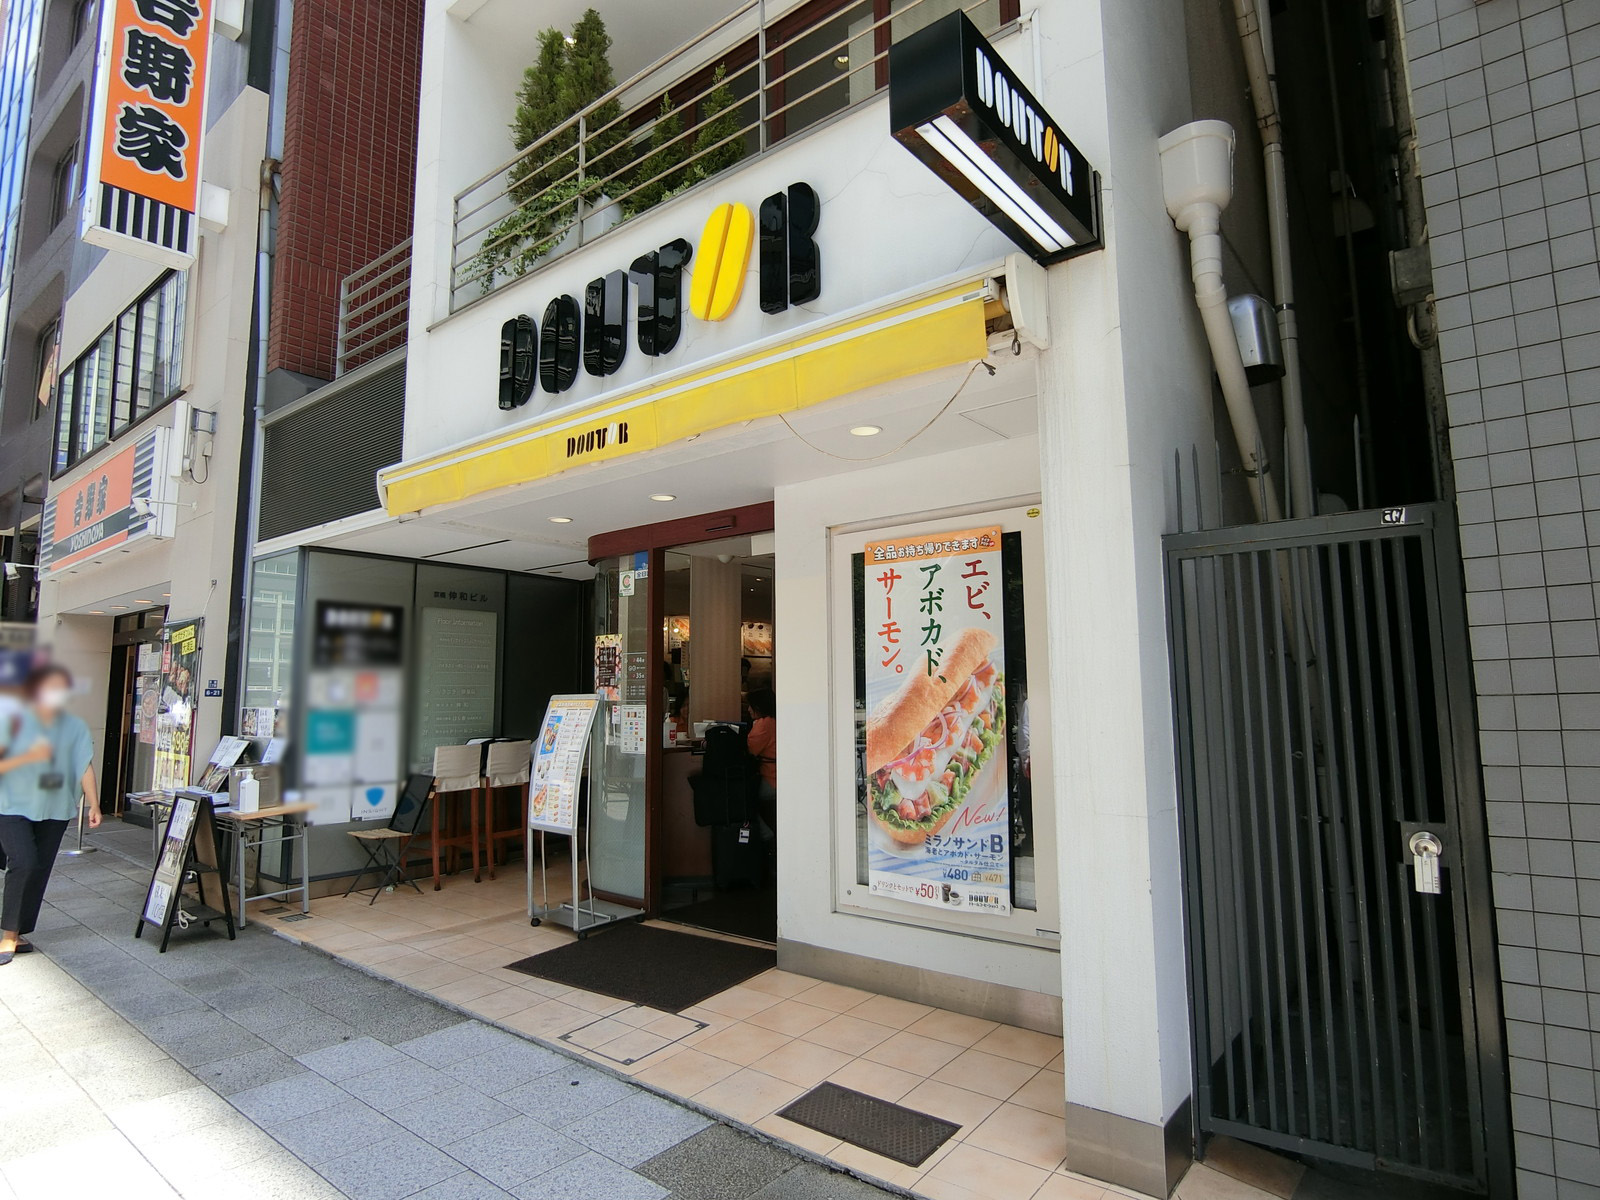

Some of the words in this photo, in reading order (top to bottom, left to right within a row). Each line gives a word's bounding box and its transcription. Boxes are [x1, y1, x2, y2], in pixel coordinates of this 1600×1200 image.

[975, 47, 1073, 197] DOUTOR
[498, 181, 821, 411] DOUTOR
[566, 422, 629, 458] DOUTOR
[73, 474, 109, 528] 吉野家
[70, 522, 104, 553] YOSHINOYA
[873, 537, 979, 561] 全品お持ち帰りできます
[961, 559, 992, 620] エビ、
[876, 568, 904, 674] サーモン。
[919, 563, 948, 684] アボカド、
[951, 803, 1006, 834] New!
[925, 834, 1003, 854] ミラノサンドB
[943, 868, 968, 881] ¥480
[985, 874, 1002, 883] ¥471
[968, 894, 999, 905] DOUTOR
